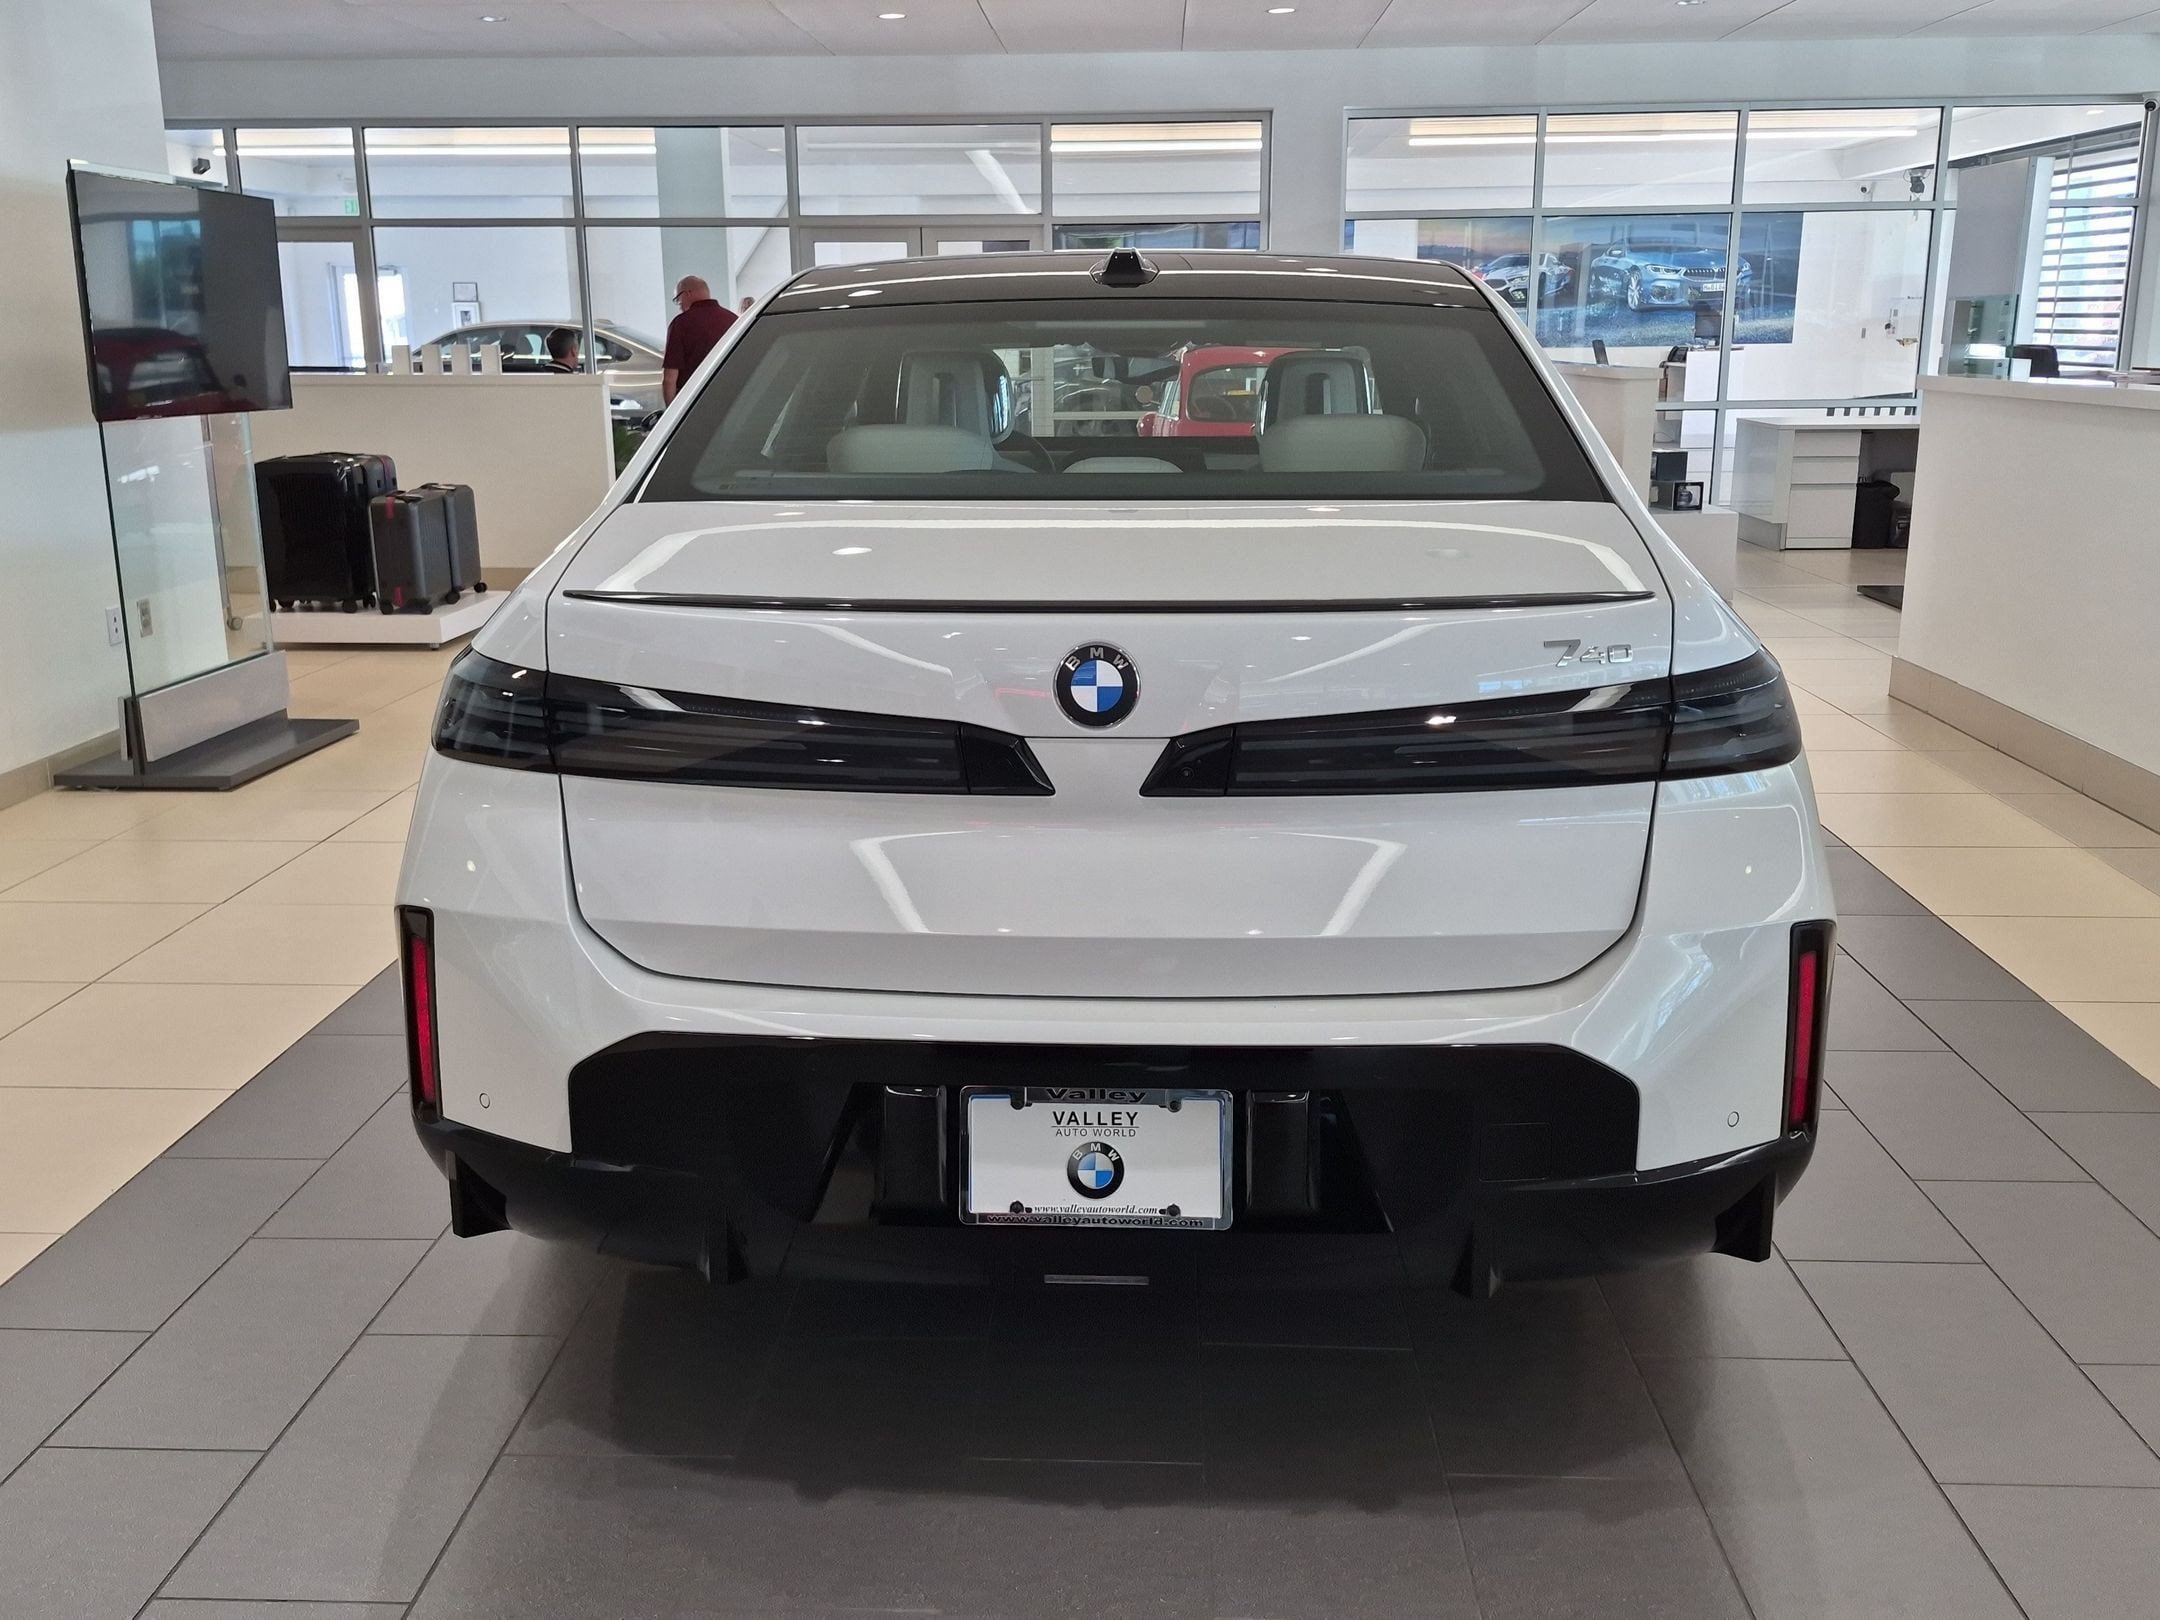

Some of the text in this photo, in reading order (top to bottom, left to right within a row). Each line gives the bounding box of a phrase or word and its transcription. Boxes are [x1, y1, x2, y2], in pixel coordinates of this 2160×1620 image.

[1065, 647, 1129, 671] BMW
[1543, 639, 1633, 668] 740
[1046, 1088, 1146, 1103] Valley
[1052, 1111, 1138, 1126] VALLEY
[1055, 1128, 1136, 1137] AUTO WORLD
[1073, 1142, 1120, 1162] BMW
[988, 1215, 1203, 1227] www.valleyautoworld.com
